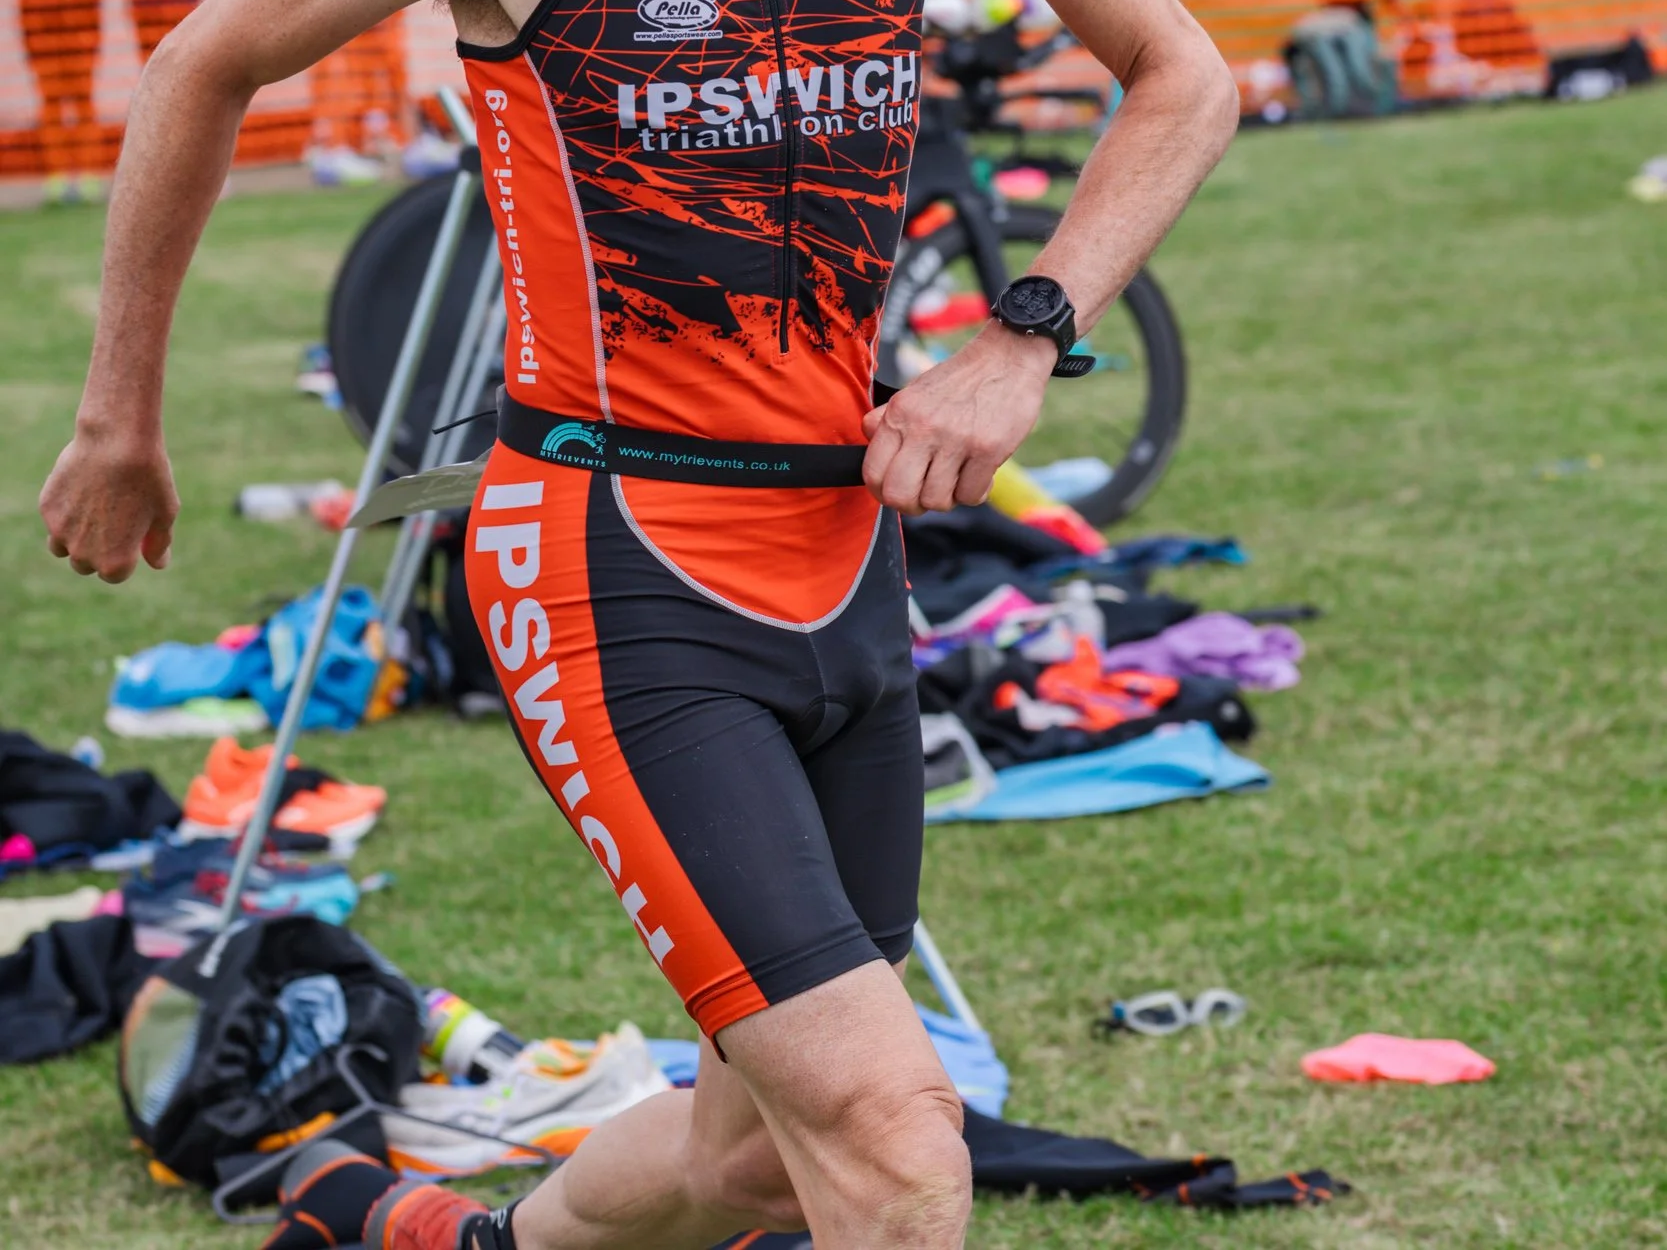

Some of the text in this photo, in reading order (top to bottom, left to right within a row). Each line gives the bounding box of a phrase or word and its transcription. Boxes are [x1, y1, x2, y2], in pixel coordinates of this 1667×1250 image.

[655, 0, 701, 16] Pella
[635, 30, 722, 41] www.pellasportswear.com
[617, 50, 916, 130] IPSWICH
[638, 97, 914, 152] triathlon club
[539, 449, 607, 468] MYTRIEVENTS
[618, 446, 791, 471] www.mytrievents.co.uk
